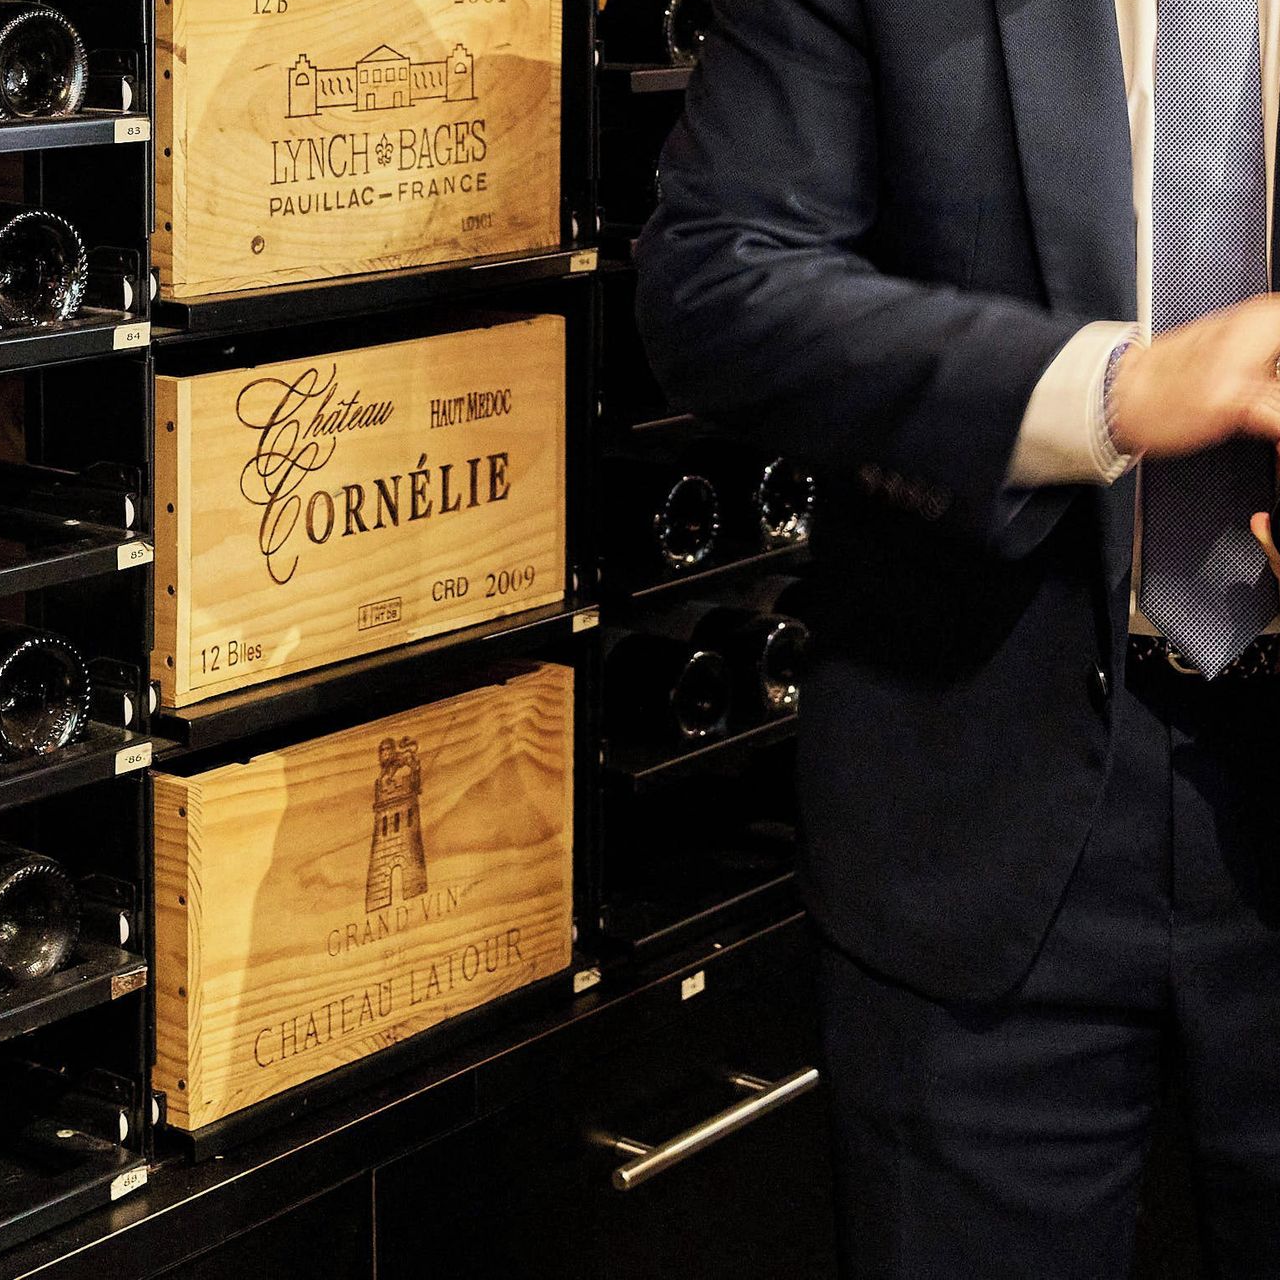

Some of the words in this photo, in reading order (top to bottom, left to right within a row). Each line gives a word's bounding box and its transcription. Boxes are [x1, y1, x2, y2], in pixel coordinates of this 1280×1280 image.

[127, 126, 141, 136] 83
[270, 131, 370, 186] LYNCH
[398, 119, 488, 172] BAGES
[126, 332, 141, 342] 84
[236, 362, 394, 476] Château
[430, 396, 464, 429] HAUT
[466, 388, 511, 422] MEDOC
[240, 436, 510, 584] CORNÉLIE
[130, 549, 144, 560] 85
[432, 577, 469, 602] CRD
[485, 566, 535, 599] 2009
[201, 647, 220, 674] 12
[228, 641, 262, 666] Blles
[327, 907, 410, 958] GRAND
[422, 888, 461, 921] VIN
[253, 978, 394, 1068] CHATEAU
[409, 927, 522, 1007] LATOUR
